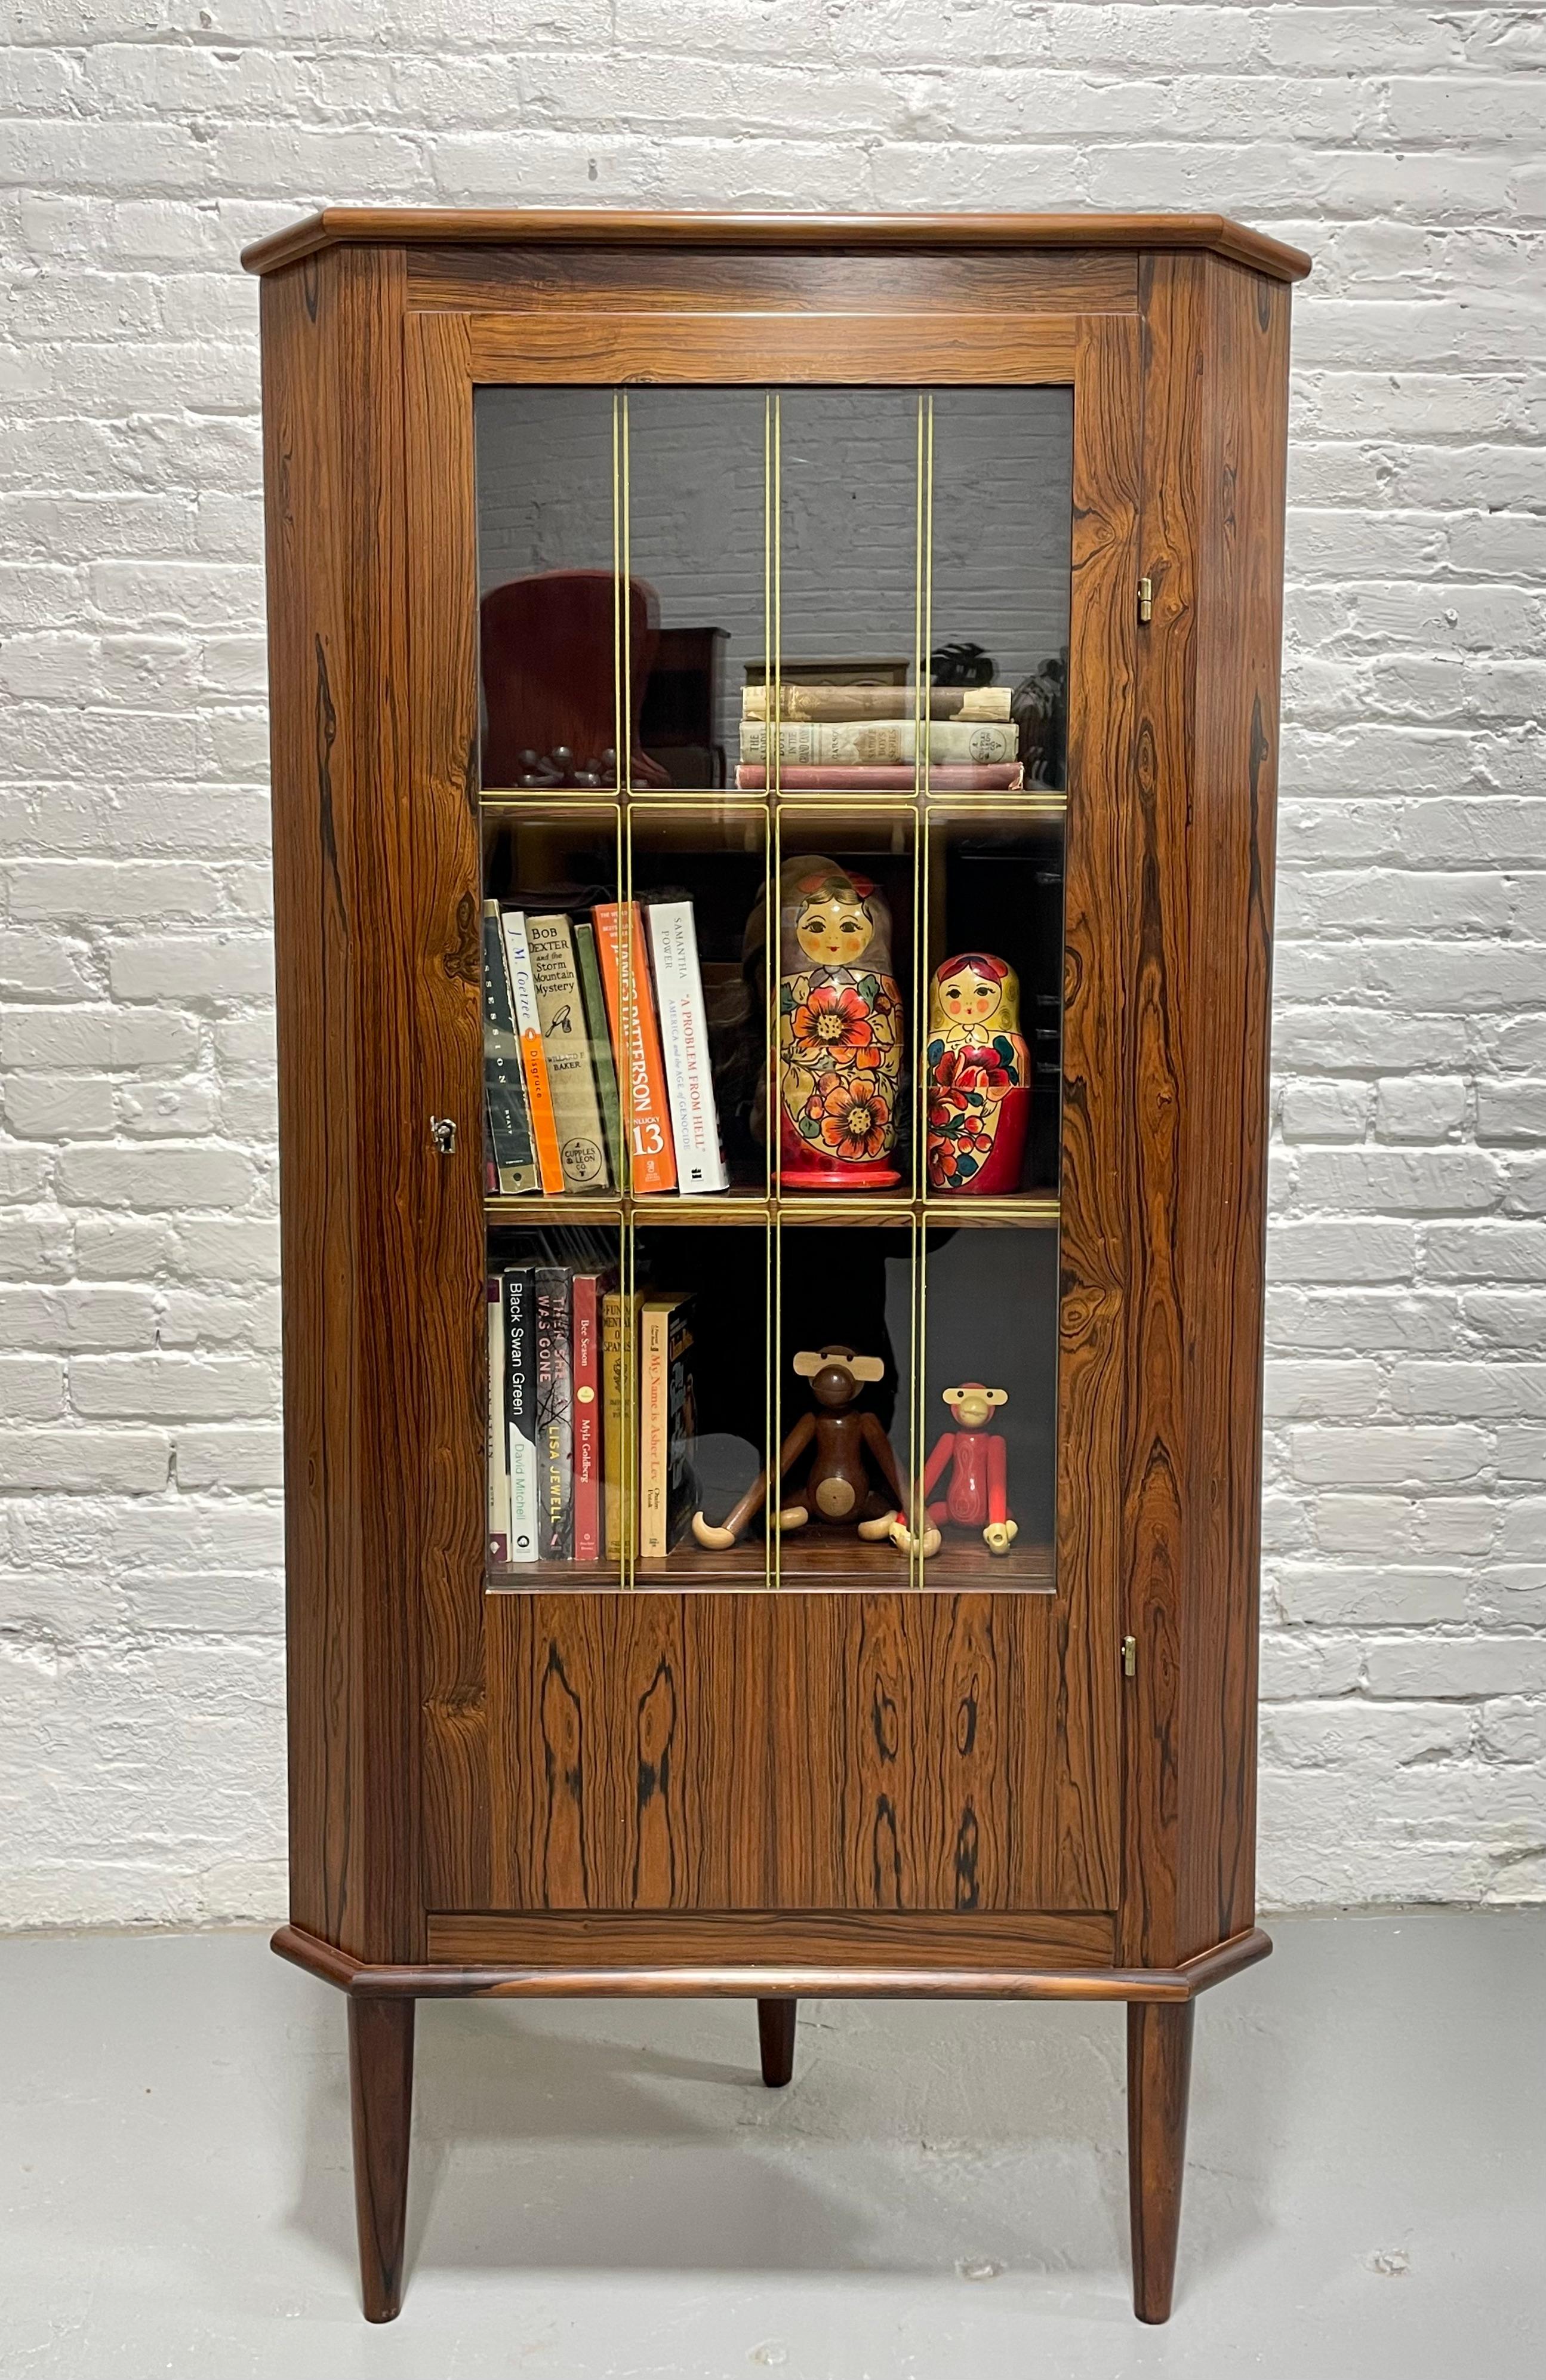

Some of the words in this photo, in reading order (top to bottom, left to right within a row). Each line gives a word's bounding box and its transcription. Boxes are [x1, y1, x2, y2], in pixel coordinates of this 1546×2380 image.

[750, 734, 759, 751] THE
[528, 940, 569, 953] DEXTER
[531, 928, 558, 940] BOB
[673, 917, 687, 979] SAMANTHA
[512, 947, 526, 965] M.
[661, 931, 673, 969] POWER
[534, 969, 574, 983] Mountain
[536, 962, 566, 972] Storm
[517, 971, 531, 1019] Coetzee
[535, 982, 574, 997] Mystery
[669, 999, 679, 1042] AMERICA
[682, 1011, 697, 1072] PROBLEM
[553, 1061, 581, 1070] BAKER
[623, 1005, 652, 1112] PATTERSON
[675, 1071, 684, 1089] AGE
[677, 1091, 686, 1100] of
[689, 1075, 701, 1112] FROM
[627, 1116, 660, 1125] NLUCKY
[679, 1101, 691, 1151] GENOCIDE
[565, 1148, 595, 1157] CUPPLES
[633, 1123, 664, 1156] 13
[575, 1154, 595, 1163] LEON
[510, 1283, 523, 1322] Black
[538, 1295, 550, 1330] WAS
[581, 1319, 590, 1336] Bee
[511, 1328, 524, 1367] Swan
[538, 1337, 552, 1383] GONE
[581, 1338, 590, 1366] Season
[650, 1354, 661, 1374] My
[512, 1372, 525, 1415] Green
[651, 1377, 660, 1409] Name
[580, 1419, 591, 1440] Myla
[651, 1412, 660, 1421] is
[549, 1426, 560, 1460] LISA
[651, 1425, 660, 1456] Asher
[515, 1443, 525, 1474] David
[580, 1443, 591, 1483] Goldberg
[651, 1461, 660, 1482] Lev
[515, 1478, 525, 1520] Mitchell
[550, 1465, 562, 1523] JEWELL
